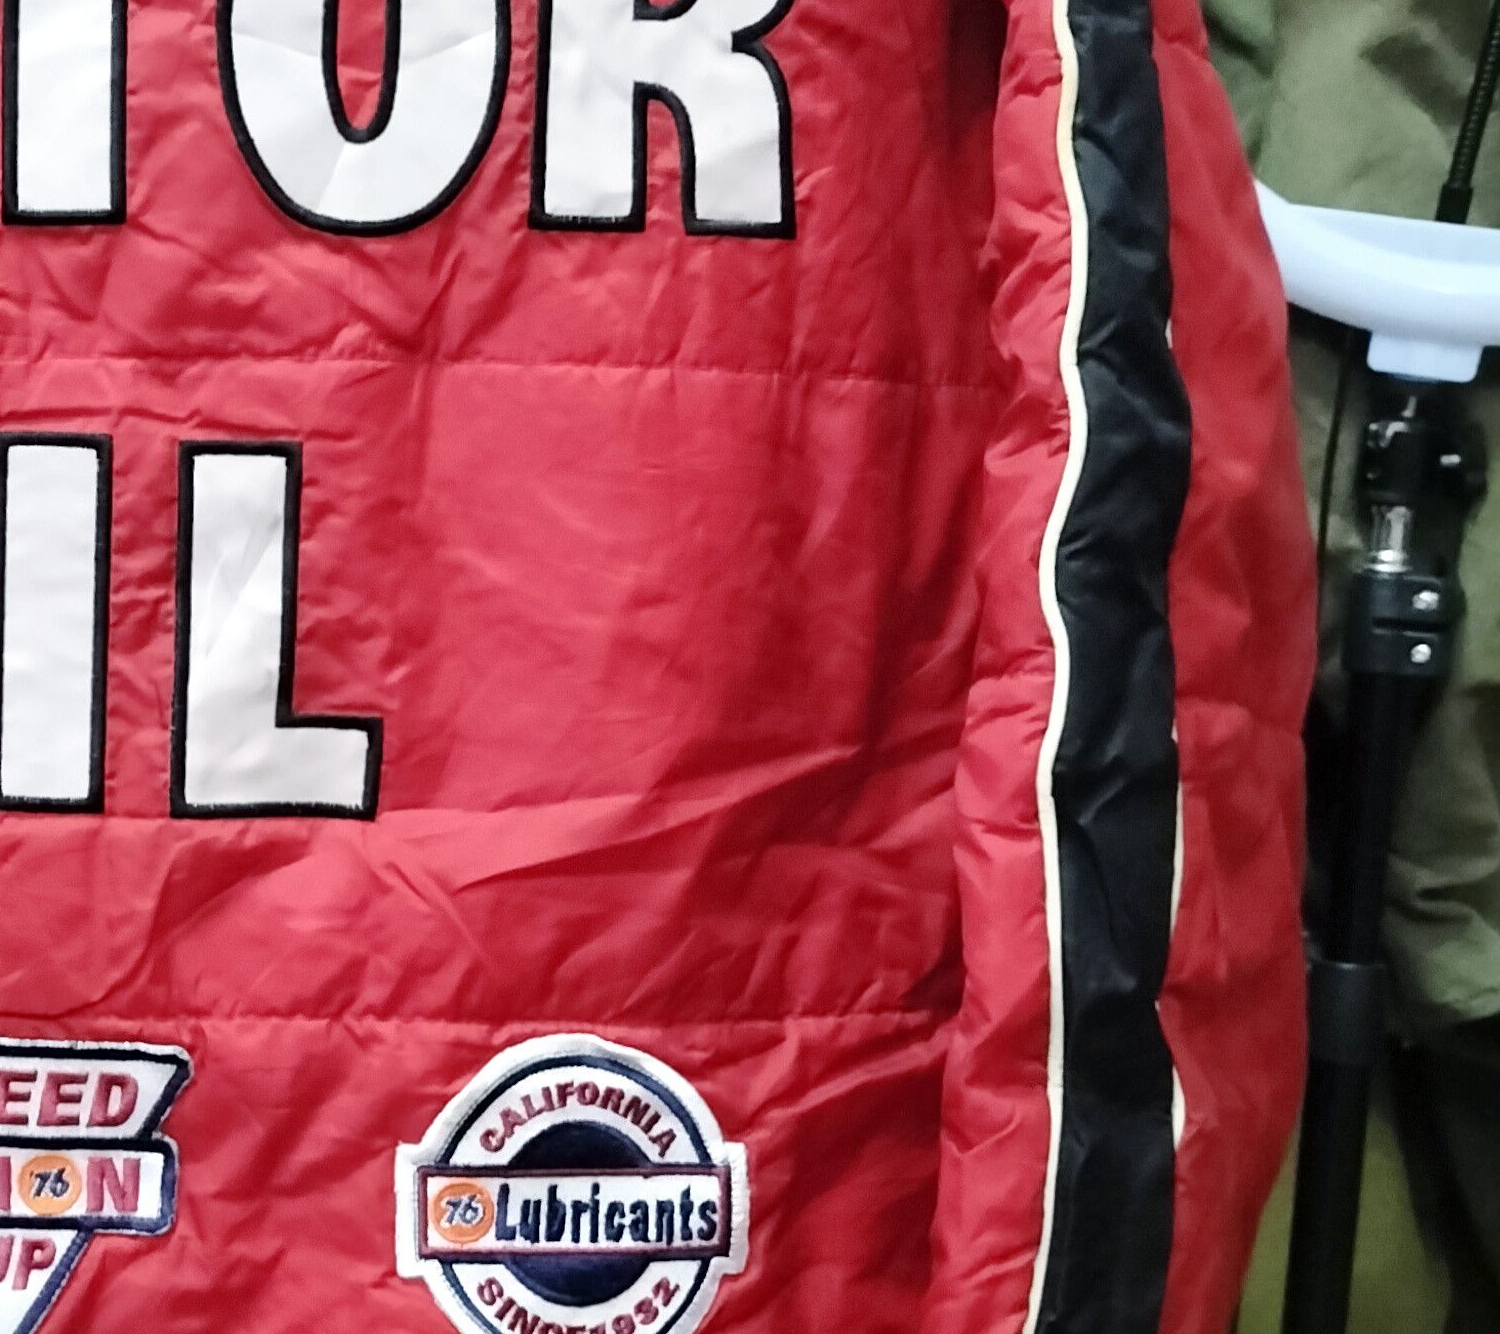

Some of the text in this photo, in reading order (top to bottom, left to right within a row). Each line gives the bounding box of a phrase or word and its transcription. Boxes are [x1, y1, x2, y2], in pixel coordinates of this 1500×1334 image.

[479, 1080, 677, 1158] CALIFORNIA
[440, 1182, 717, 1245] 76 Lubricants
